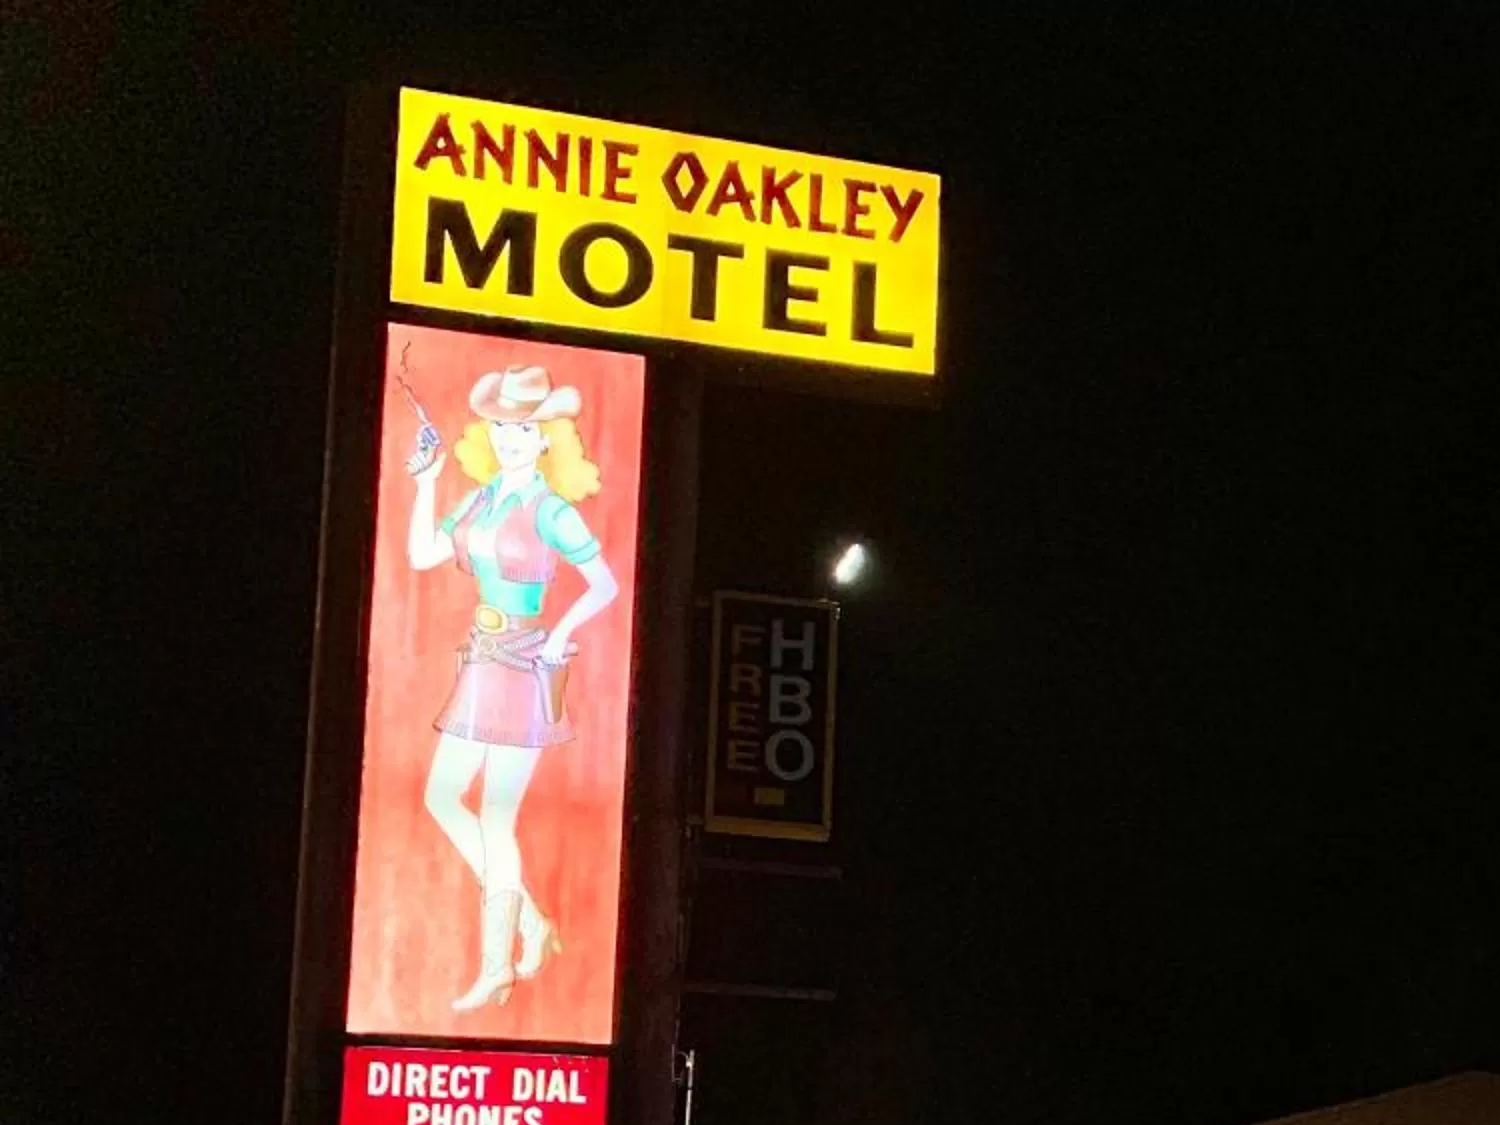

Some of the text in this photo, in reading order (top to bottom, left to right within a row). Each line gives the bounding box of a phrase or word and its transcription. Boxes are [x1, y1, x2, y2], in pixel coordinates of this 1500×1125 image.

[414, 112, 925, 244] ANNIE OAKLEY
[423, 195, 915, 350] MOTEL
[727, 624, 766, 772] FREE
[764, 618, 816, 782] HBO
[367, 1061, 587, 1105] DIRECT DIAL
